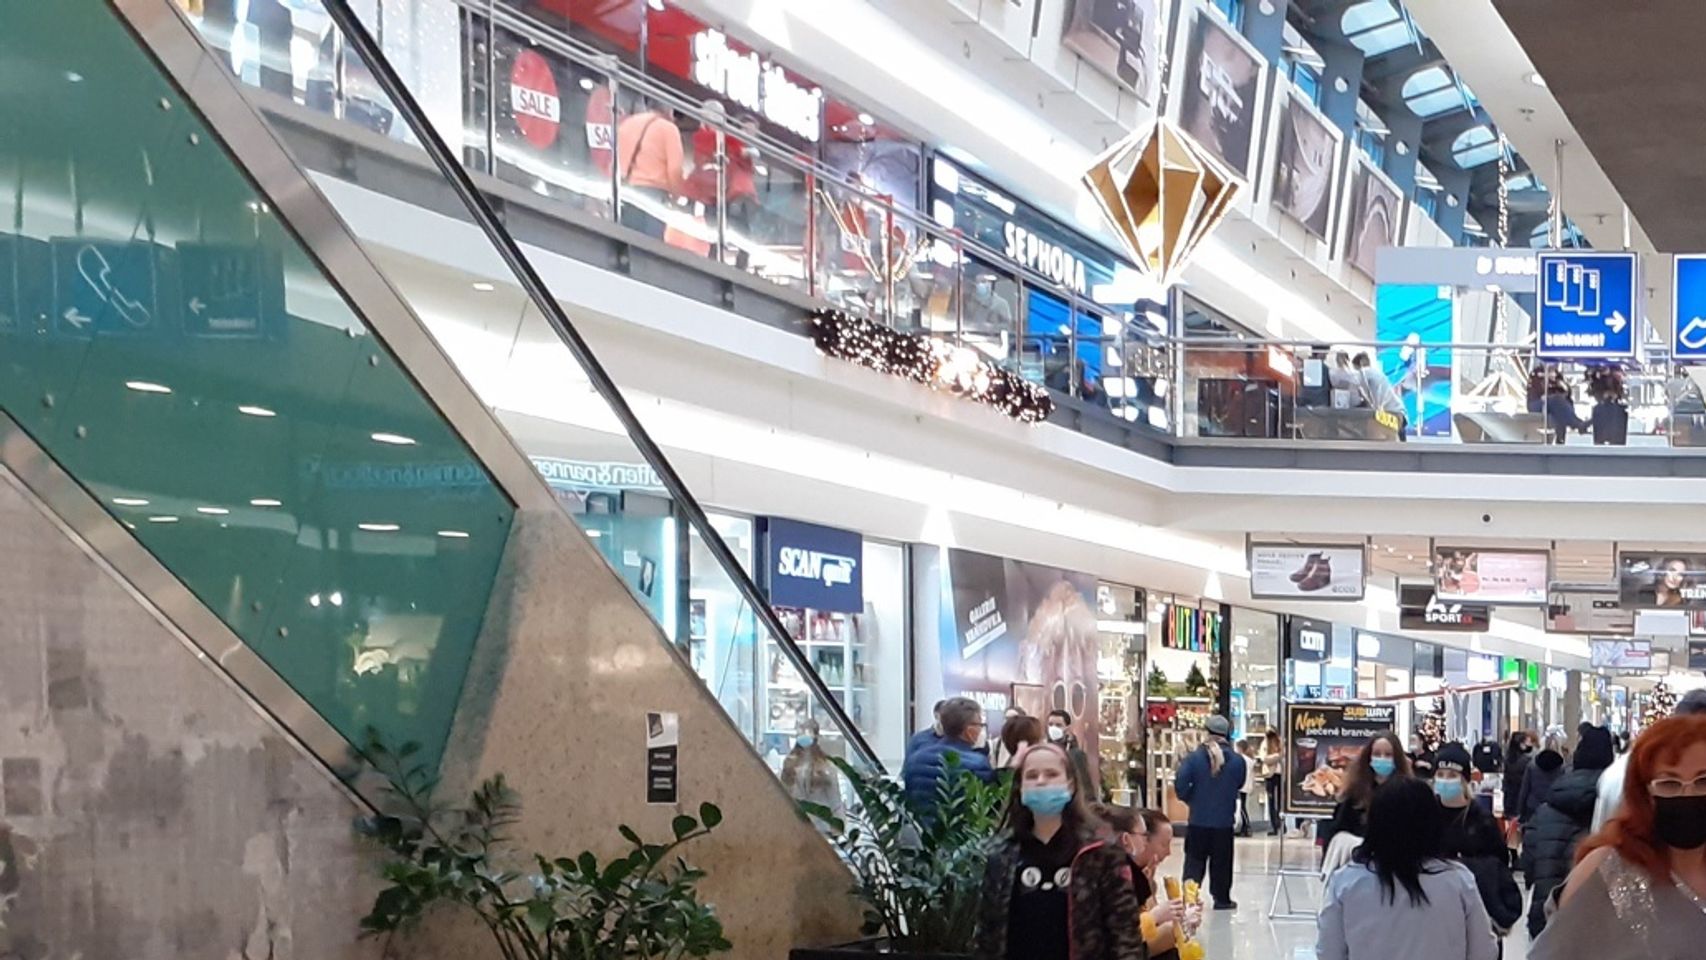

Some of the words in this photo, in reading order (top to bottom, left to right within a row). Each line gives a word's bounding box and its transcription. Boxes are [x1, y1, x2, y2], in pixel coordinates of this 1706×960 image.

[519, 92, 551, 113] SALE
[595, 127, 611, 146] SA
[1005, 221, 1086, 295] SEPHORA
[1544, 332, 1605, 347] bankomat
[778, 546, 821, 580] SCAN
[1168, 604, 1220, 653] BUTLERS
[1344, 706, 1393, 717] SUBWAY
